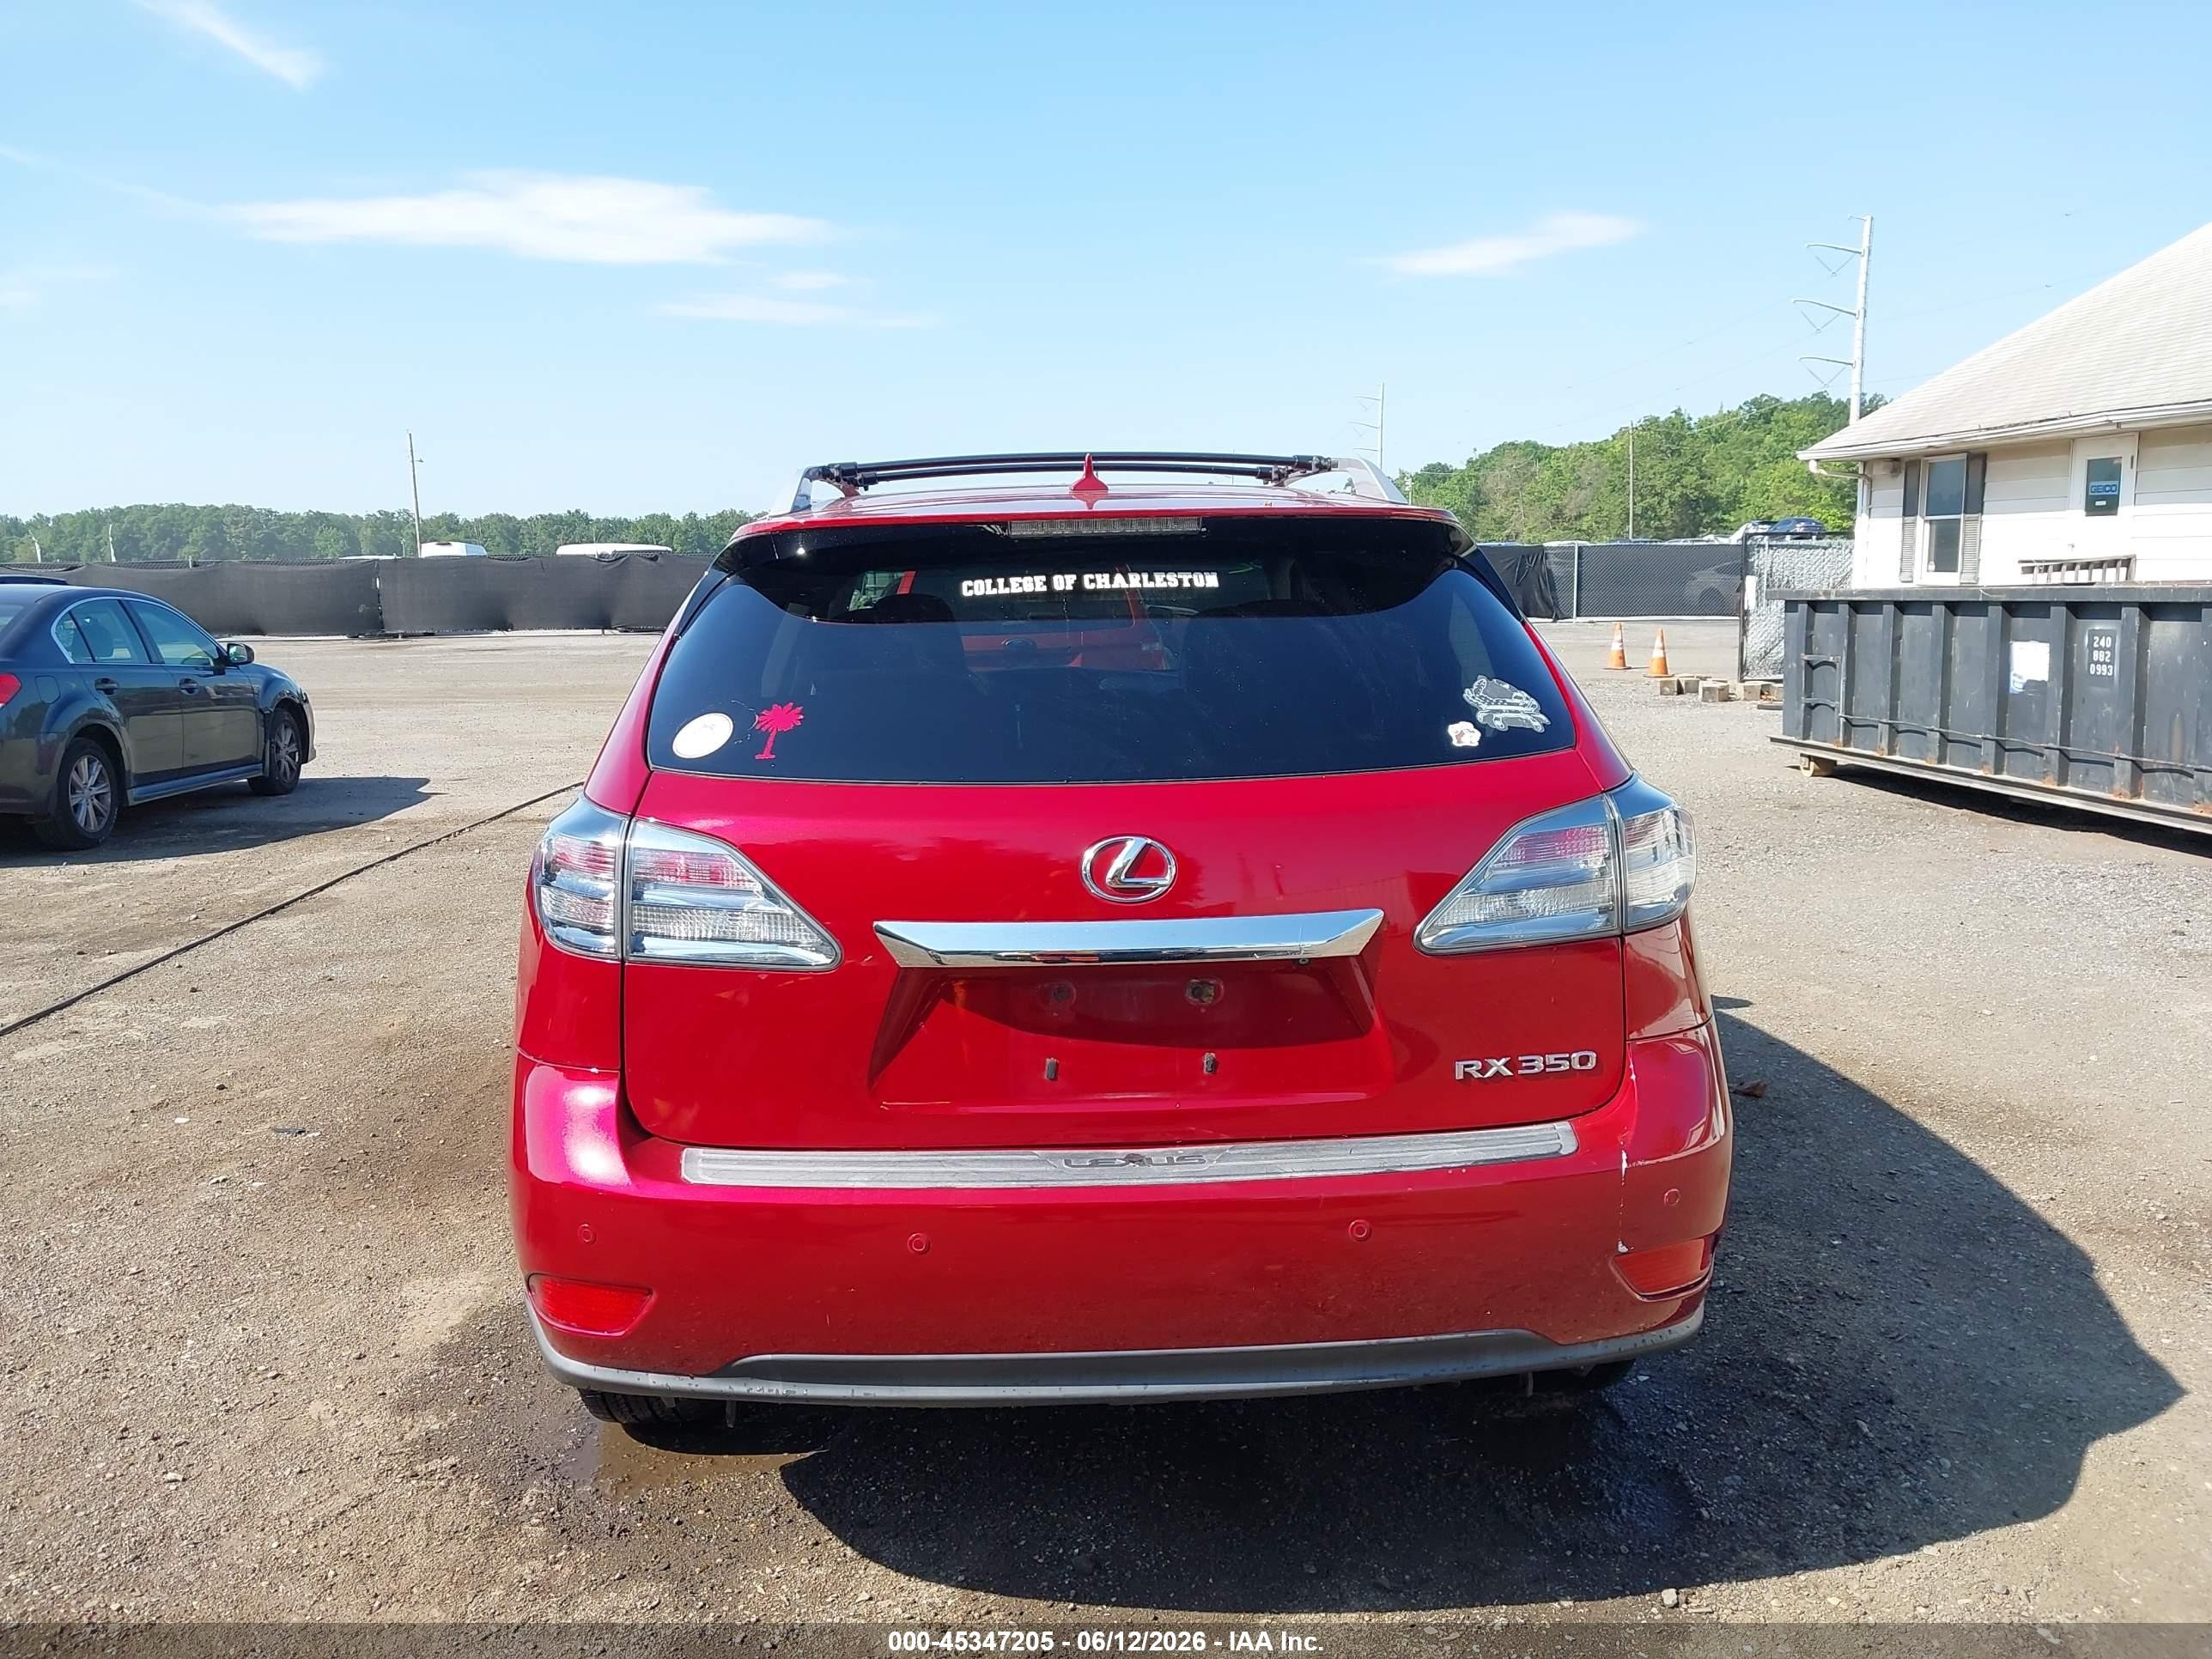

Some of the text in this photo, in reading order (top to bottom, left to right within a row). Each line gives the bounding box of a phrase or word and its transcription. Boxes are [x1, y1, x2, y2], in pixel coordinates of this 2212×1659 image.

[2090, 483, 2118, 494] GEICO
[962, 572, 1219, 597] COLLEGE OF CHARLESTON
[2094, 635, 2112, 647] 240
[2089, 664, 2113, 676] 0993
[1455, 1050, 1597, 1079] RX 350
